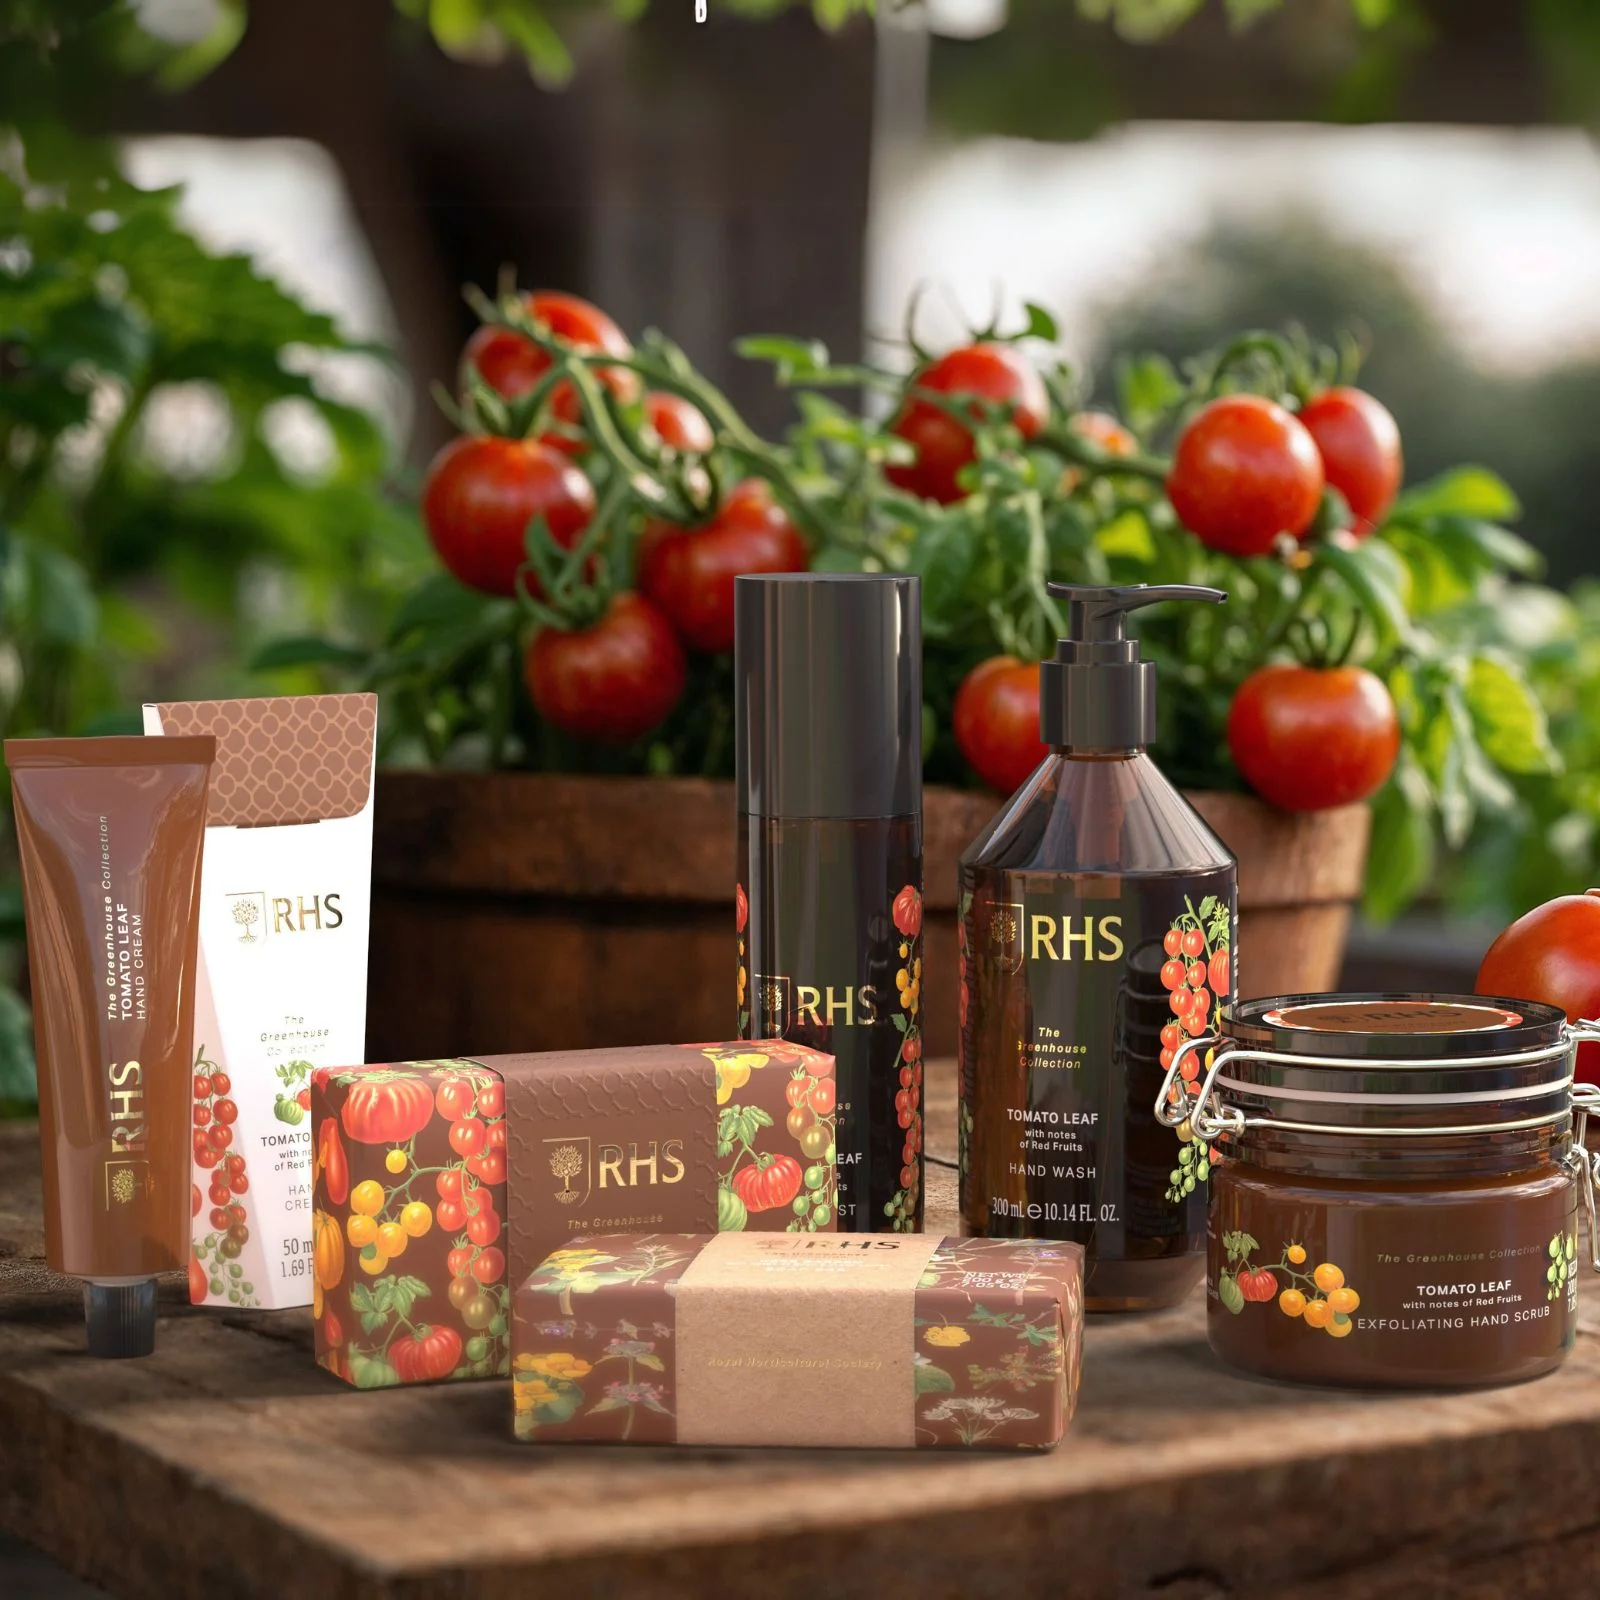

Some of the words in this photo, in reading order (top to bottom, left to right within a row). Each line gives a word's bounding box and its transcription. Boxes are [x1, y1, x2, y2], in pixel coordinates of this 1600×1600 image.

[100, 816, 111, 889] Collection
[272, 894, 344, 933] RHS
[117, 904, 129, 944] LEAF
[105, 896, 116, 986] Greenhouse
[132, 914, 144, 969] CREAM
[1030, 915, 1124, 961] RHS
[120, 950, 132, 1020] TOMATO
[135, 976, 146, 1019] HAND
[797, 985, 878, 1026] RHS
[108, 993, 118, 1020] The
[260, 1029, 329, 1042] Greenhouse
[1039, 1027, 1060, 1038] The
[1020, 1056, 1081, 1069] Collection
[108, 1060, 145, 1152] RHS
[1007, 1108, 1059, 1124] TOMATO
[1064, 1112, 1099, 1125] LEAF
[260, 1132, 310, 1147] TOMATO
[1025, 1129, 1045, 1138] with
[1048, 1130, 1077, 1140] notes
[279, 1150, 299, 1158] with
[1020, 1140, 1029, 1149] of
[1032, 1140, 1050, 1150] Red
[1053, 1142, 1083, 1152] Fruits
[274, 1162, 284, 1171] of
[288, 1161, 304, 1170] Red
[598, 1139, 686, 1189] RHS
[837, 1153, 863, 1164] EAF
[1009, 1162, 1046, 1177] HAND
[1052, 1166, 1096, 1179] WASH
[288, 1184, 312, 1196] HAN
[285, 1199, 311, 1211] CRE
[992, 1197, 1009, 1216] 300
[1010, 1201, 1025, 1218] mL
[1044, 1203, 1076, 1221] 10.14
[1080, 1204, 1097, 1222] FL.
[1100, 1204, 1120, 1222] OZ.
[567, 1220, 588, 1230] The
[284, 1238, 299, 1256] 50
[805, 1241, 901, 1250] RHS
[1376, 1254, 1400, 1263] The
[1406, 1253, 1484, 1264] Greenhouse
[1490, 1245, 1541, 1260] Collection
[281, 1259, 305, 1278] 1.69
[1417, 1284, 1476, 1296] TOMATO
[1481, 1280, 1512, 1293] LEAF
[1402, 1300, 1426, 1310] with
[1429, 1300, 1460, 1309] notes
[1462, 1298, 1474, 1308] of
[1476, 1296, 1494, 1306] Red
[1497, 1294, 1522, 1304] Fruits
[1357, 1317, 1464, 1330] EXFOLIATING
[1471, 1312, 1510, 1328] HAND
[1514, 1305, 1551, 1322] SCRUB
